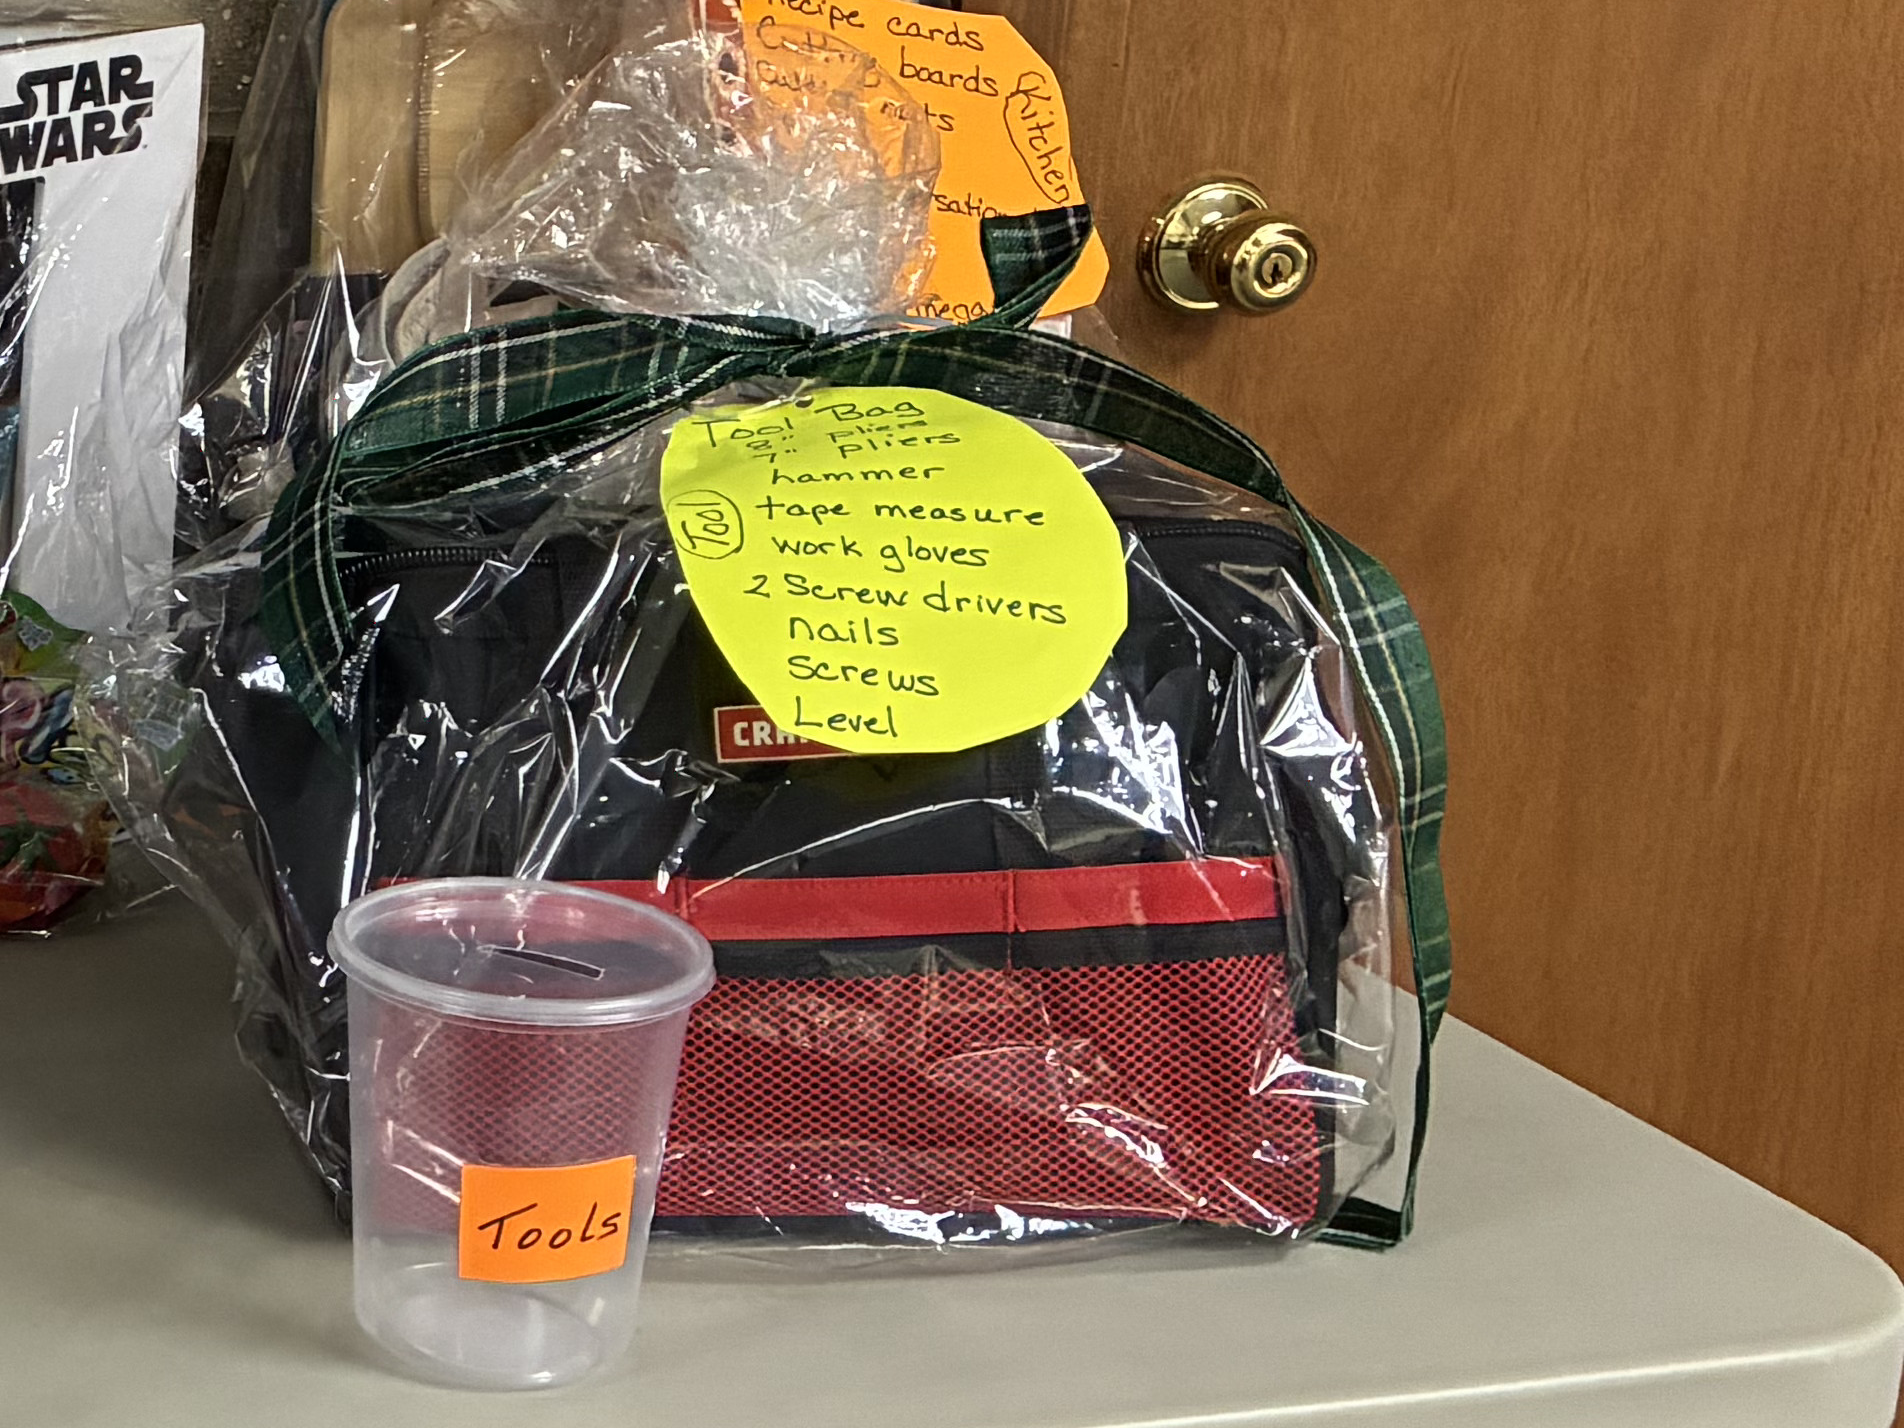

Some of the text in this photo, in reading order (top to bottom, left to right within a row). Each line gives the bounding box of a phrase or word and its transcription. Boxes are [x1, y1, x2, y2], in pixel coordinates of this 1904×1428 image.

[886, 13, 986, 52] cards
[897, 45, 1000, 99] boards
[837, 432, 961, 460] pliers
[771, 466, 945, 485] hammer
[754, 496, 1045, 526] tape measure
[771, 535, 990, 574] work gloves
[742, 574, 771, 599] 2
[922, 580, 1067, 625] drivers
[793, 695, 898, 739] Level
[476, 1200, 622, 1250] Tools
